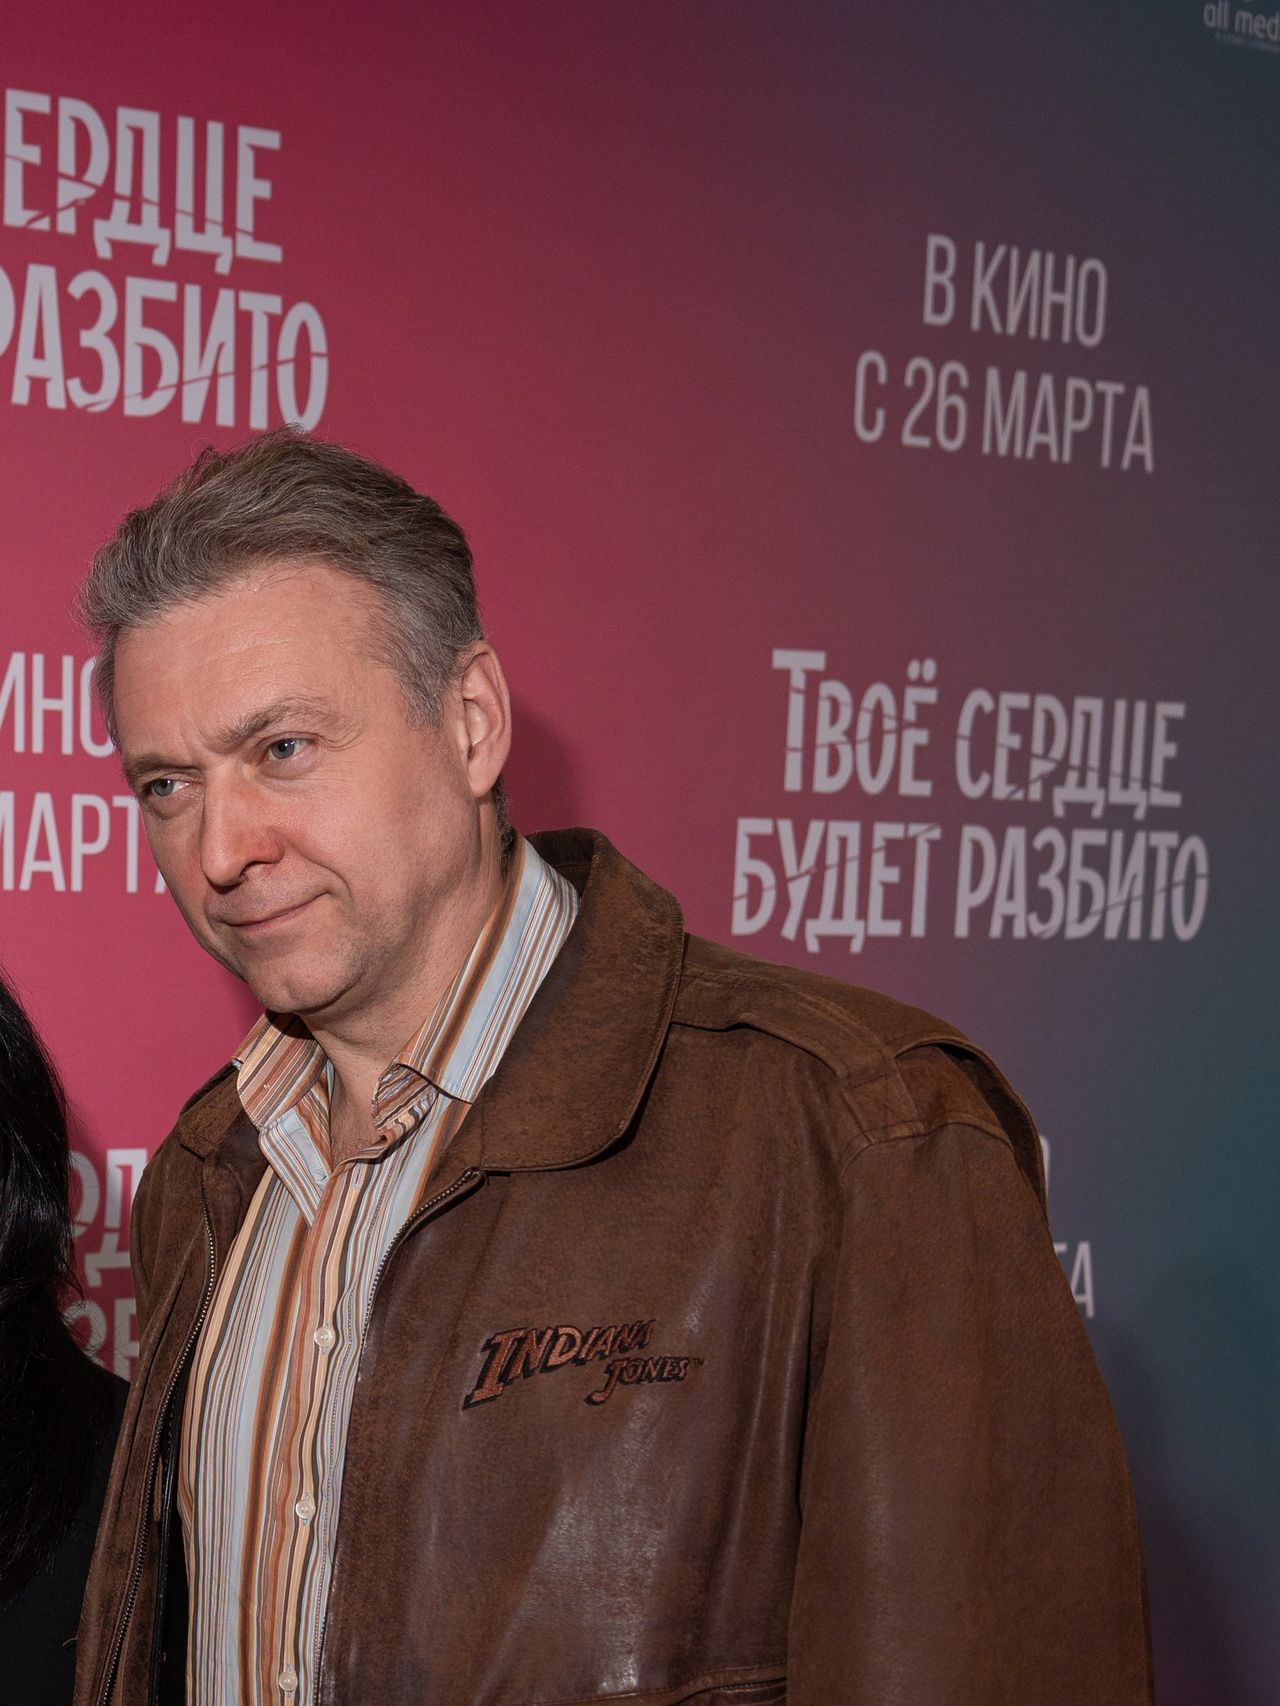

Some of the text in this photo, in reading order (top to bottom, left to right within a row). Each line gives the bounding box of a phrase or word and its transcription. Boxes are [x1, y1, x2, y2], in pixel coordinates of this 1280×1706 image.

[923, 233, 1107, 348] В КИНО
[853, 350, 1154, 473] С 26 МАРТА
[772, 648, 1186, 820] ТВОЁ СЕРДЦЕ
[731, 817, 1209, 953] БУДЕТ РАЗБИТО
[461, 1318, 656, 1411] INDIANA
